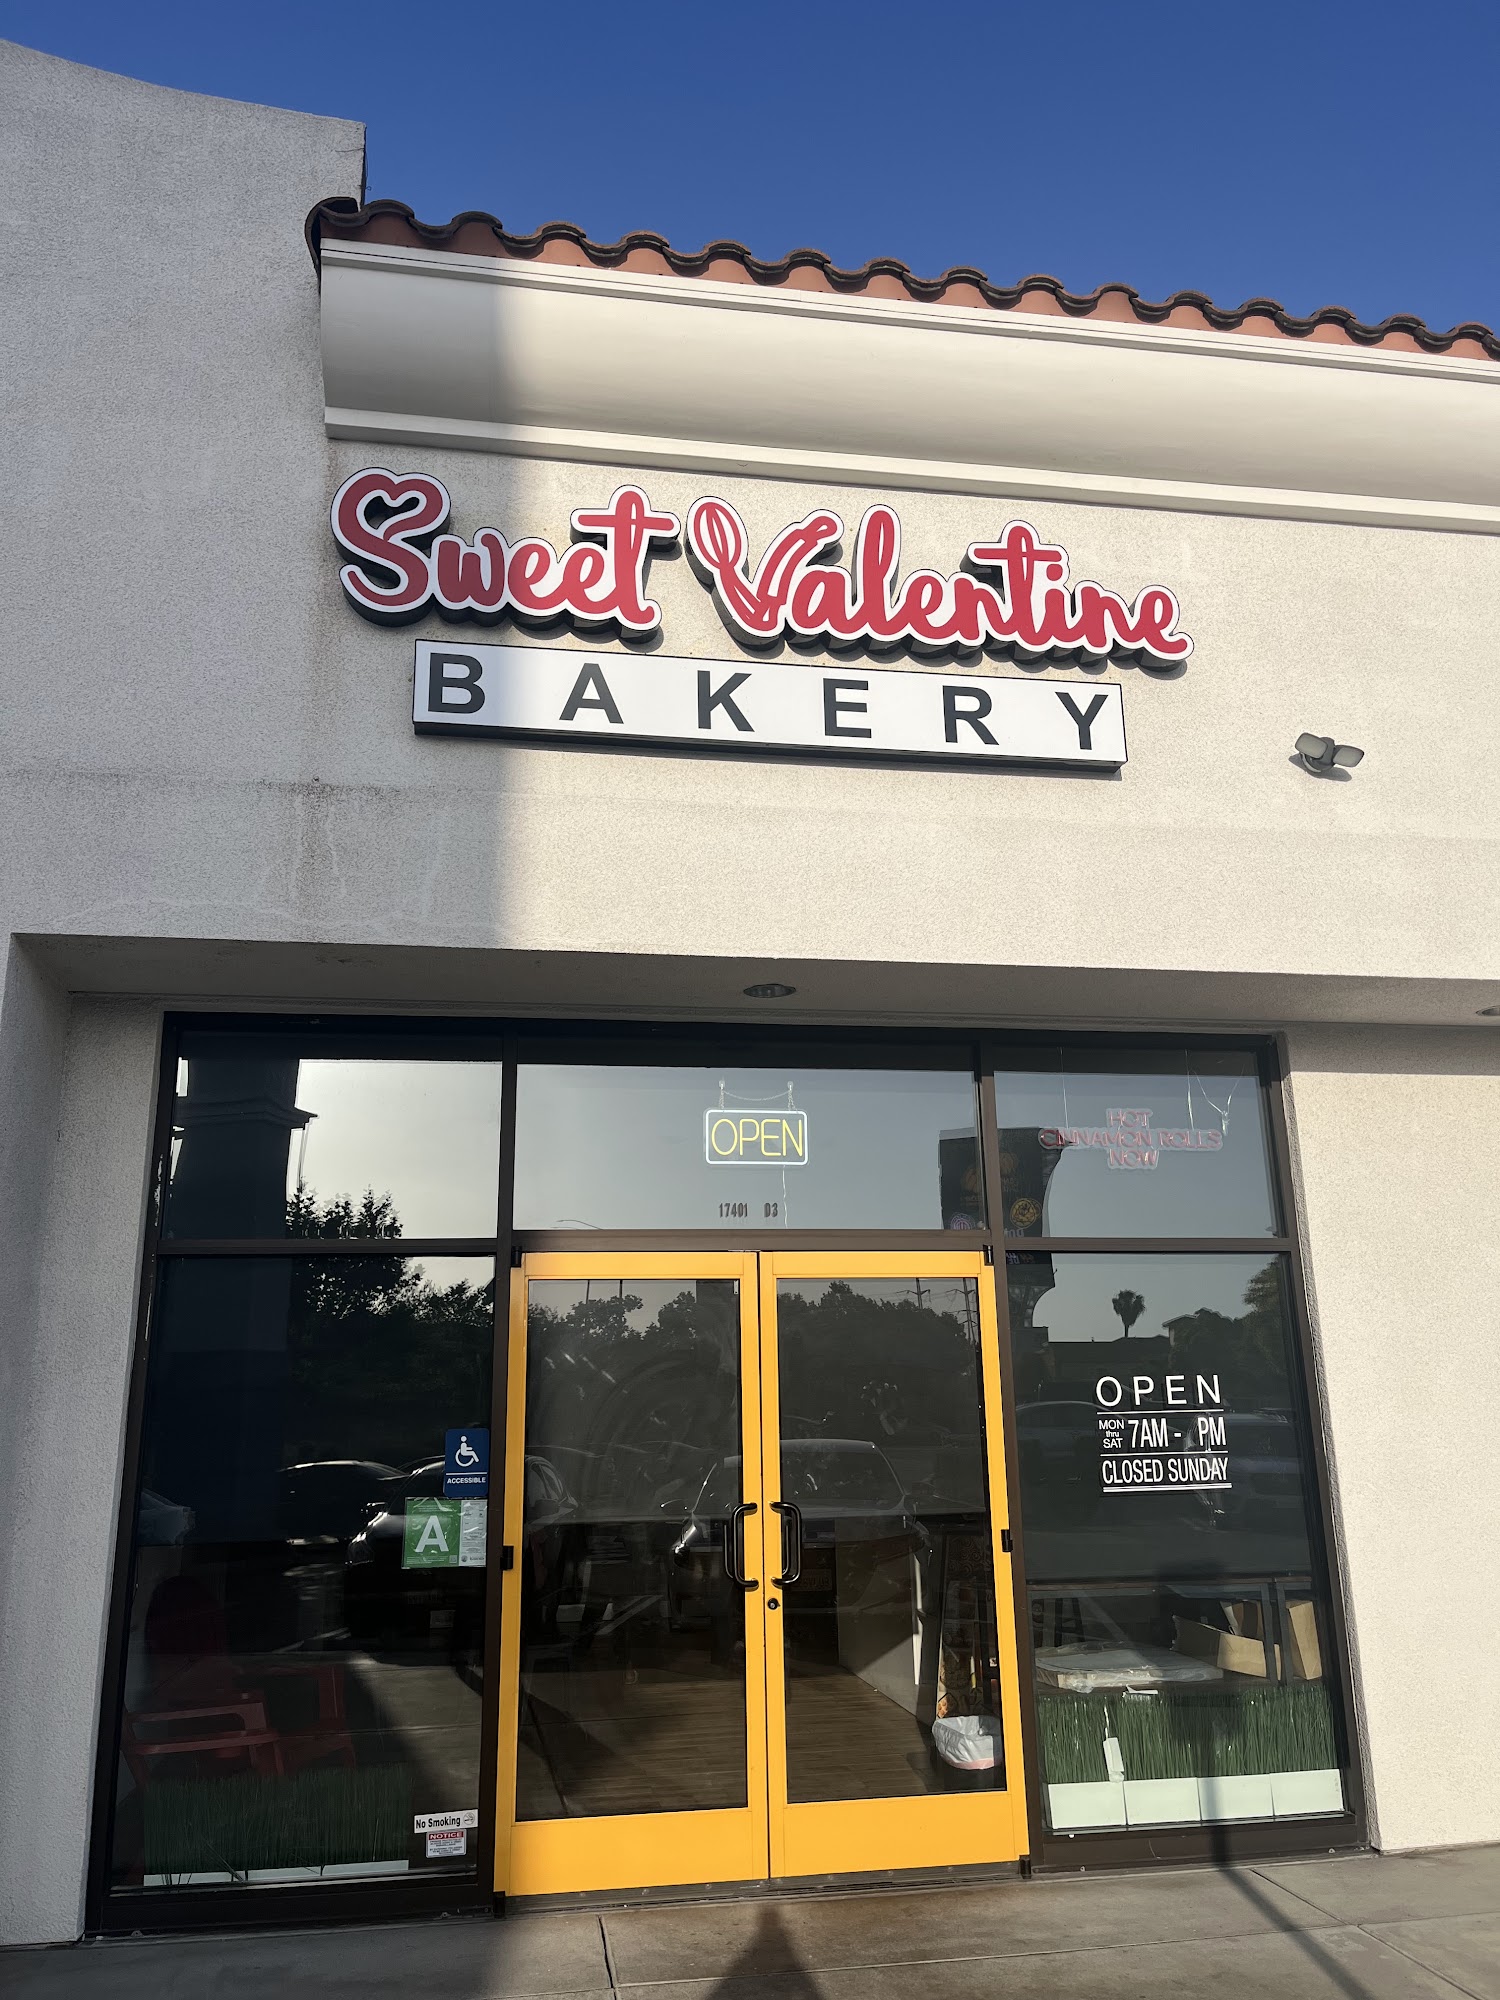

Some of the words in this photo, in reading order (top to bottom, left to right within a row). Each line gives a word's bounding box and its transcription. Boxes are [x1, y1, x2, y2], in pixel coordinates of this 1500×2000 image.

[340, 474, 676, 627] Sweet
[692, 499, 1189, 657] Valentine
[427, 652, 1109, 751] BAKERY
[1110, 1109, 1150, 1128] HOT
[711, 1118, 803, 1157] OPEN
[1040, 1129, 1152, 1148] CINNAMON
[1159, 1130, 1221, 1149] ROLLS
[1110, 1148, 1157, 1167] NOW
[718, 1202, 748, 1218] 17401
[1096, 1374, 1221, 1407] OPEN
[1098, 1419, 1124, 1430] MON
[1128, 1417, 1169, 1448] 7AM
[1198, 1416, 1227, 1447] PM
[1102, 1437, 1123, 1449] SAT
[1102, 1459, 1164, 1484] CLOSED
[1168, 1457, 1229, 1482] SUNDAY
[415, 1515, 449, 1553] A
[415, 1819, 426, 1829] No
[428, 1816, 461, 1828] Smoking
